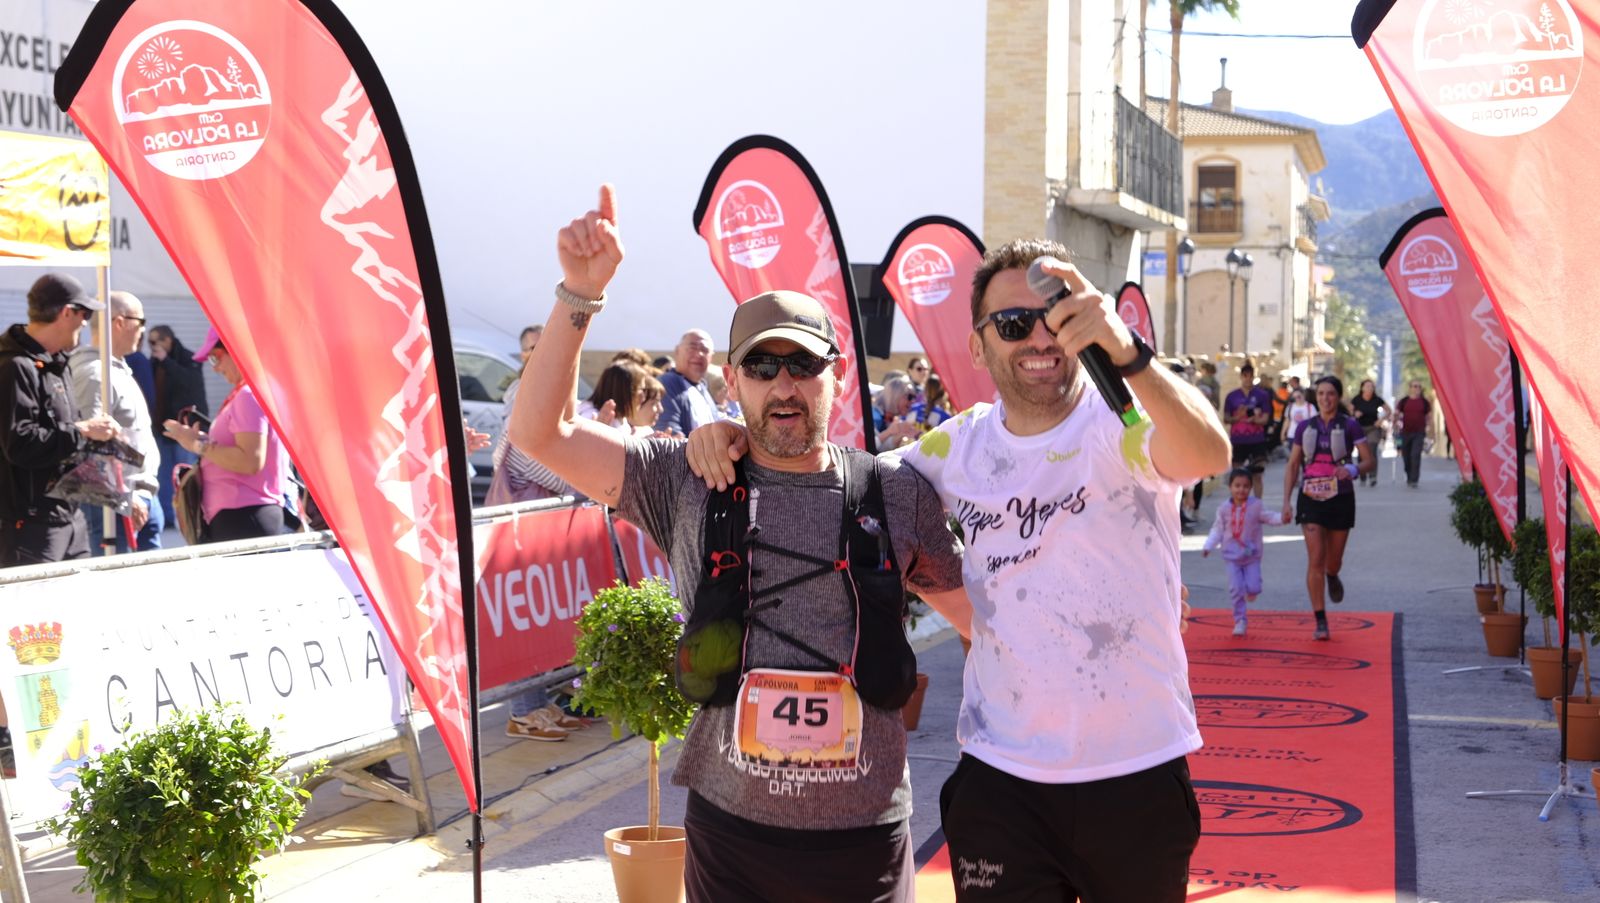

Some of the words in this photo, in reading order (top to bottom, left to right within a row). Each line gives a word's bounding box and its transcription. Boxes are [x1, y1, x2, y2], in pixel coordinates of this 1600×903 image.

[1006, 486, 1091, 540] Yepes
[479, 556, 594, 638] VEOLIA
[101, 600, 324, 652] YUNTAMENT
[106, 629, 388, 735] CANTORIA
[772, 696, 829, 727] 45
[768, 780, 807, 798] D.A.T.
